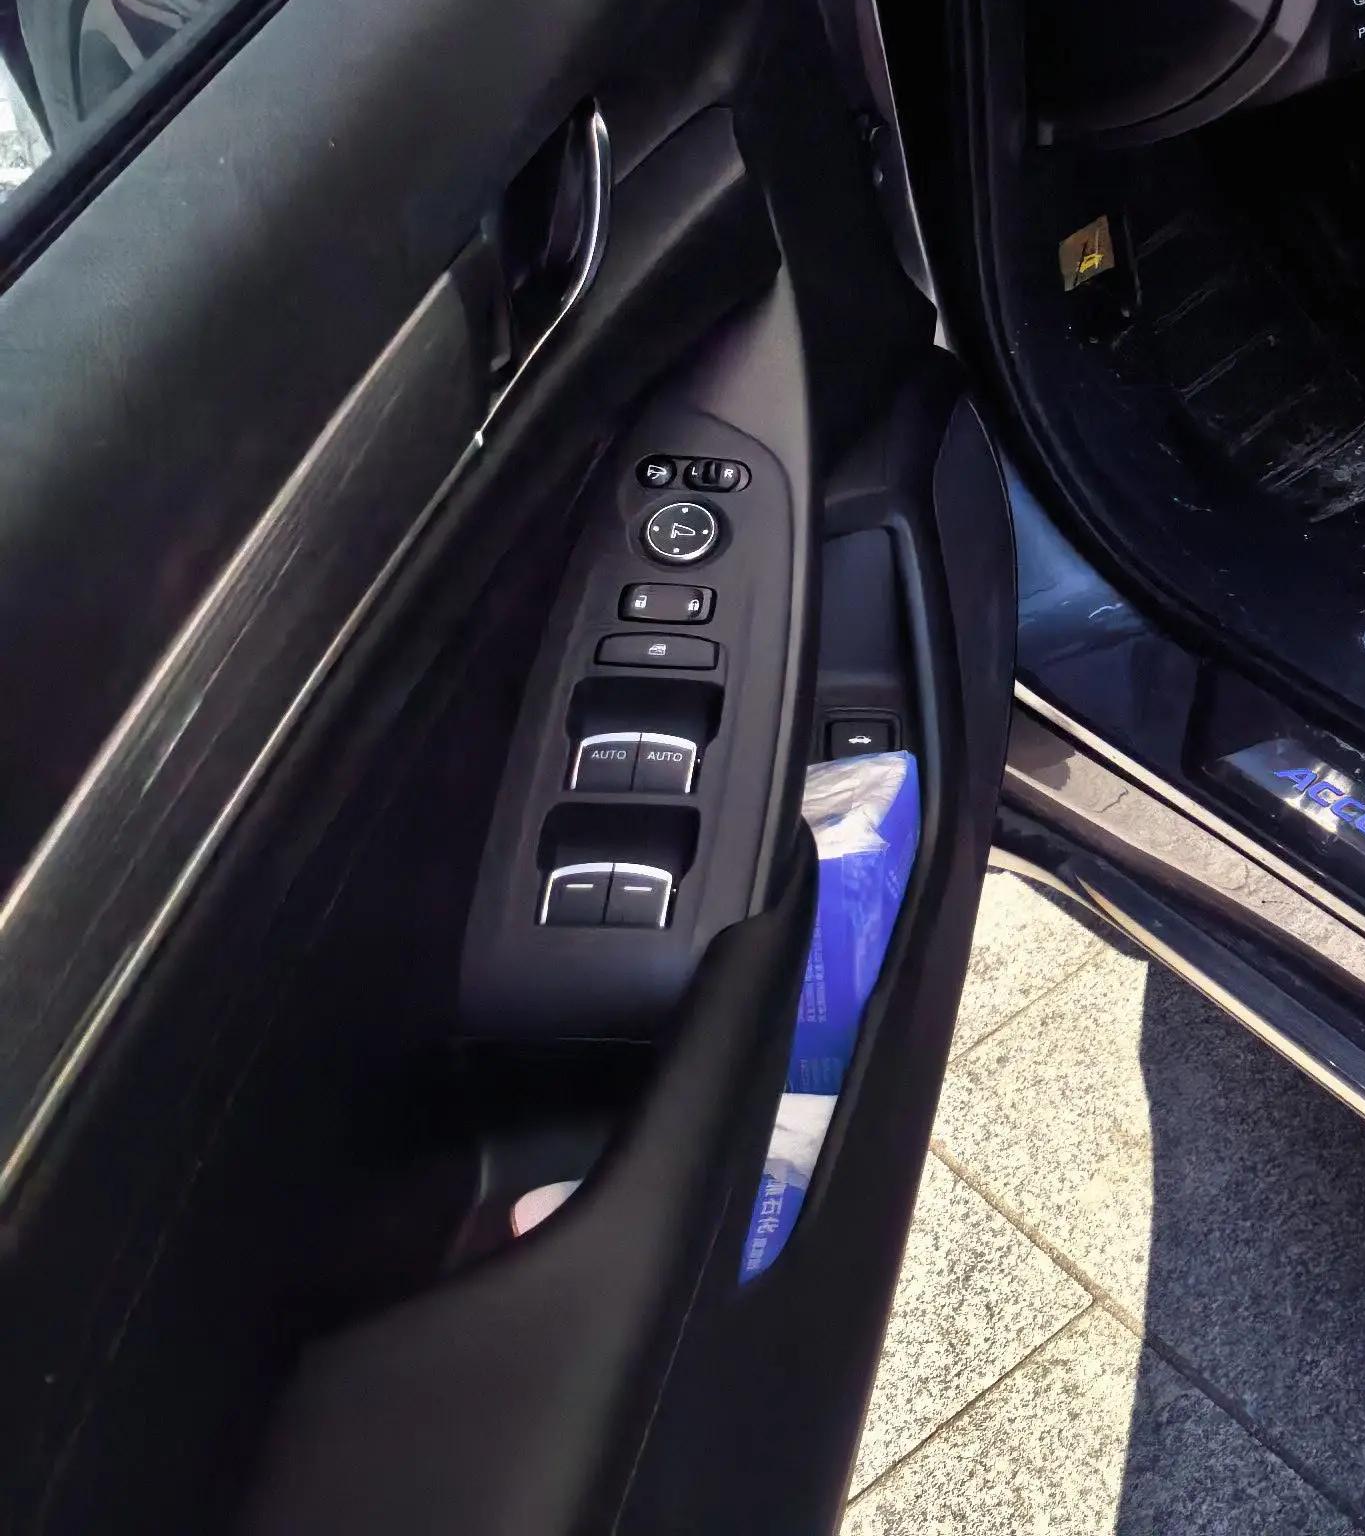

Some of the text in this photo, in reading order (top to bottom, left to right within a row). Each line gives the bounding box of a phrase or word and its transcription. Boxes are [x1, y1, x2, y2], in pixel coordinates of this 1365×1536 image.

[691, 466, 734, 478] L R
[591, 750, 683, 762] AUTO AUTO
